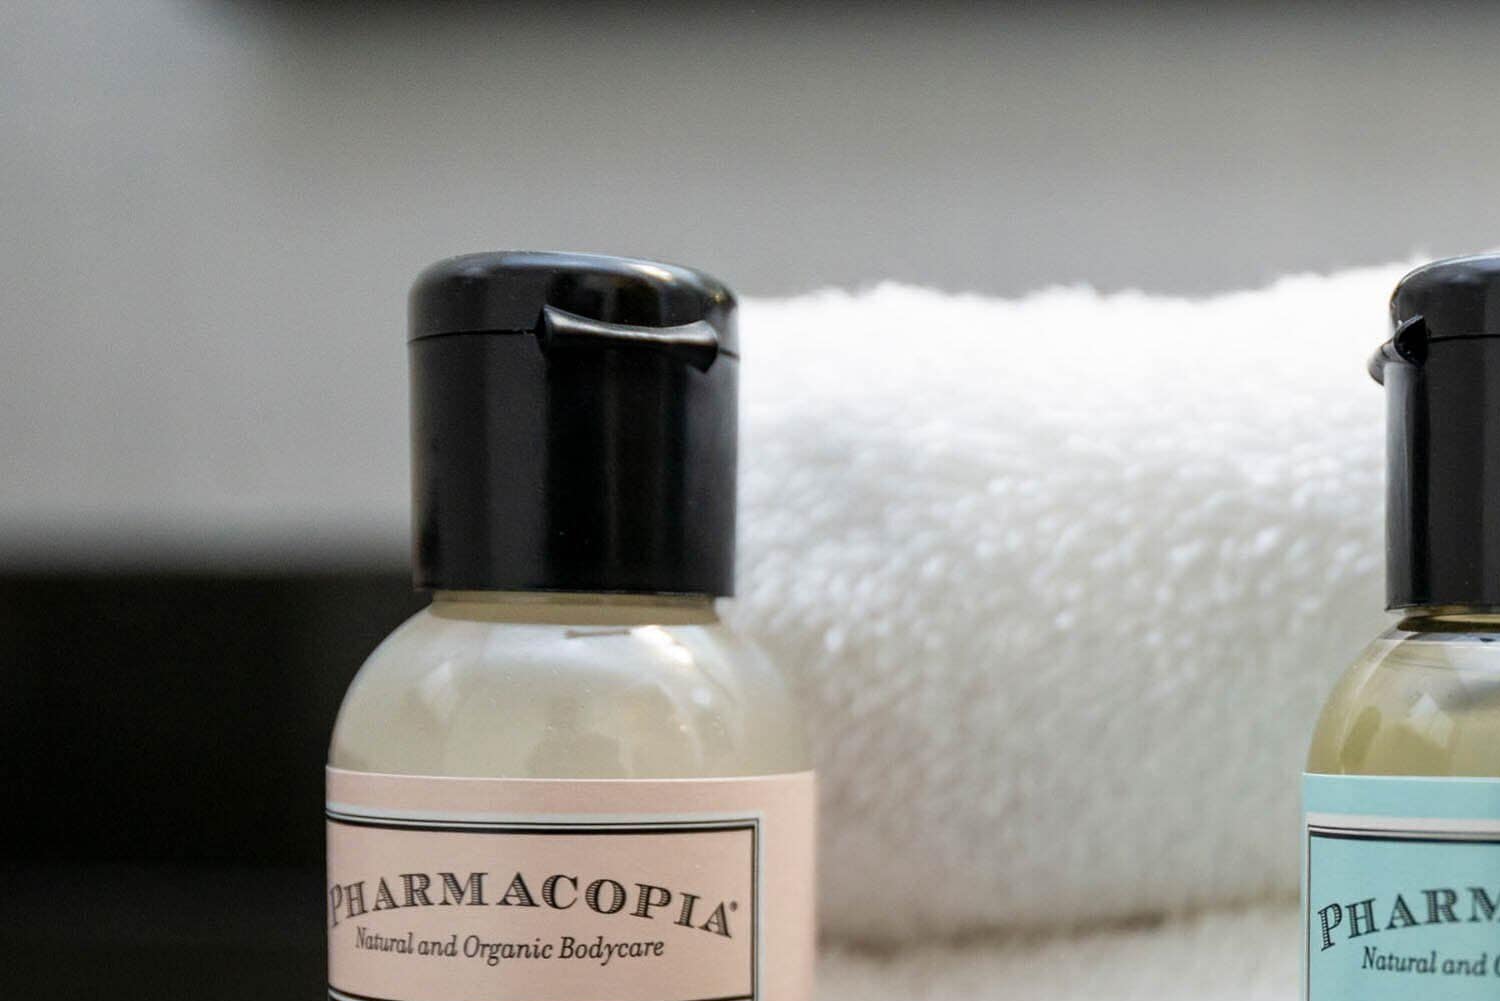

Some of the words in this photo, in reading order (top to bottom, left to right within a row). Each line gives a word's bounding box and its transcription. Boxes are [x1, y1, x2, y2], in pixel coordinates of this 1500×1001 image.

[355, 926, 414, 954] Natural
[417, 936, 458, 958] and
[463, 935, 553, 967] Organic
[559, 936, 665, 966] Bodycare
[1361, 946, 1437, 974] Natural
[1441, 953, 1487, 977] and
